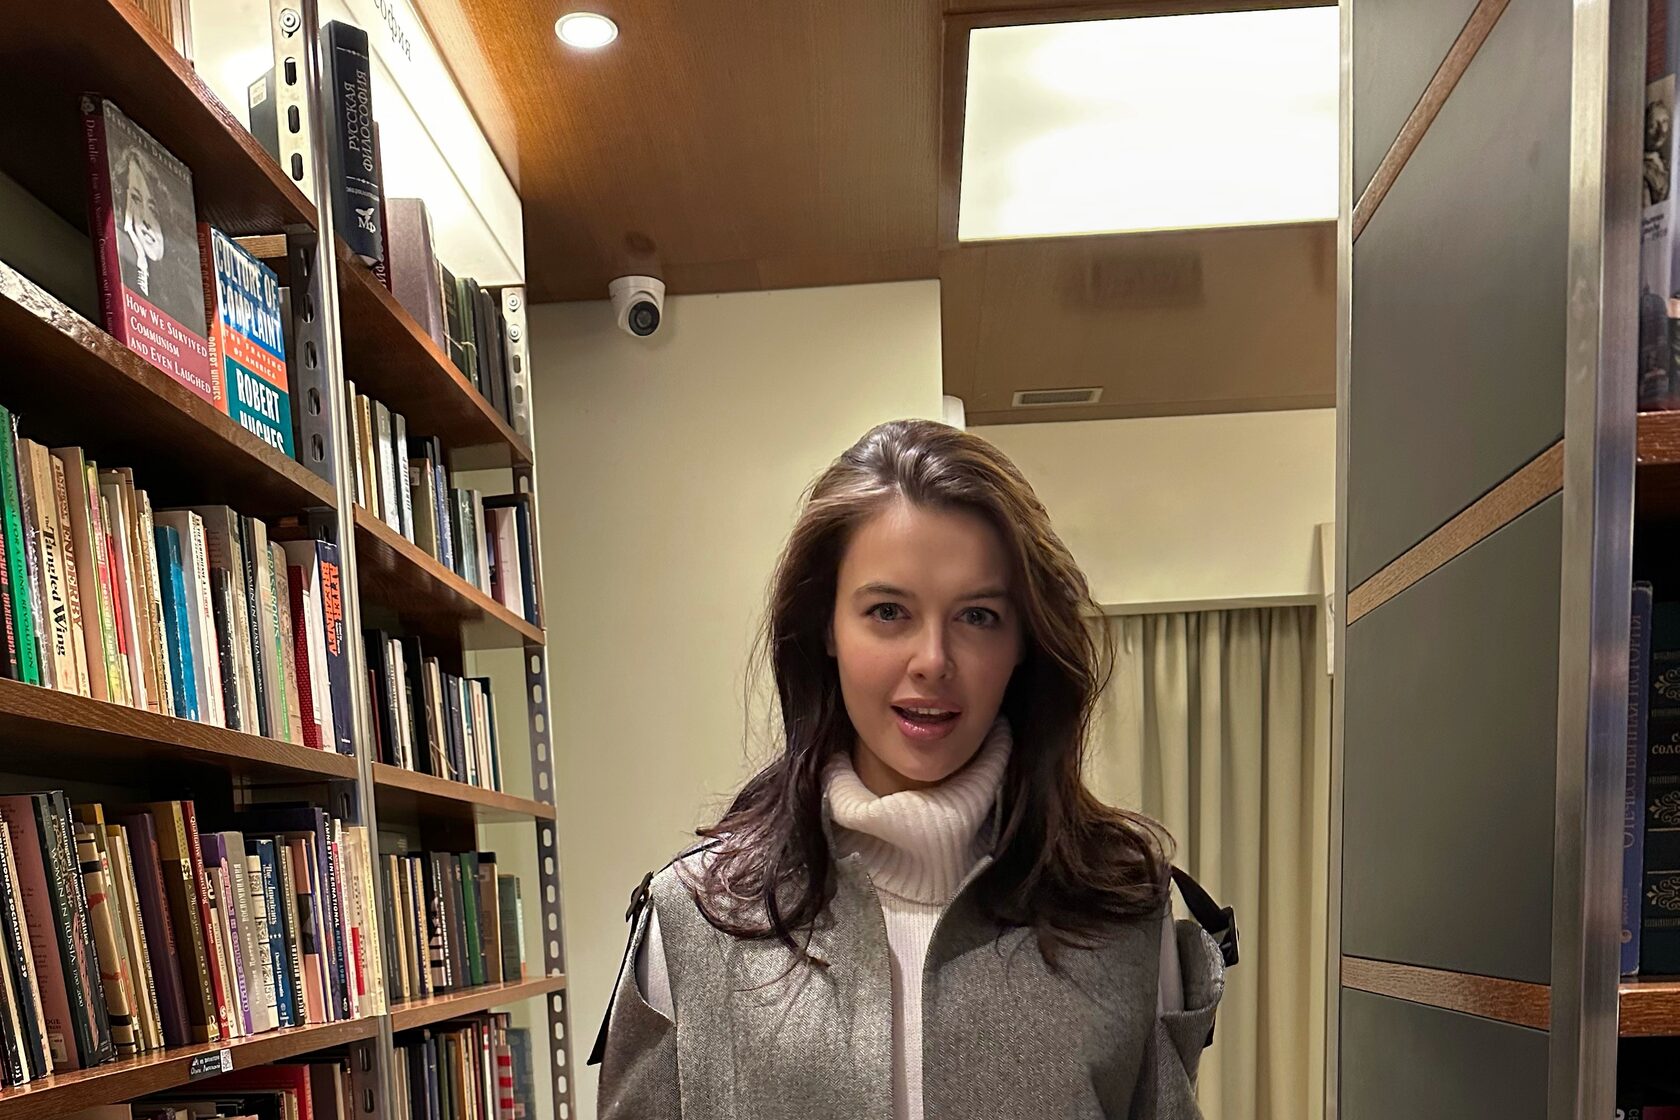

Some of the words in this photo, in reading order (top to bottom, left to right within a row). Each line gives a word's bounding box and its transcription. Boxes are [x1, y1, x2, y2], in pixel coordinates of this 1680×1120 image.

[344, 81, 360, 151] РУССКАЯ
[356, 69, 374, 172] ФИЛОСОФИЯ
[214, 236, 262, 302] CULTURE
[264, 274, 276, 311] OF
[219, 280, 282, 353] COMPLAINT
[245, 343, 283, 372] FRAYING
[245, 357, 276, 379] AMERICA
[236, 368, 280, 424] ROBERT
[15, 557, 25, 596] LIVING
[20, 598, 34, 669] REVOLUTION
[43, 526, 62, 602] Tangled
[53, 604, 68, 656] Wing
[62, 524, 83, 631] ENDERBY
[266, 549, 280, 637] GRASSROOTS
[319, 560, 336, 656] BREZHNEV
[329, 563, 341, 621] AFTER
[51, 848, 65, 898] WOMEN
[60, 902, 68, 917] IN
[60, 817, 72, 867] Huntington
[72, 872, 83, 913] American
[80, 913, 89, 946] Politics
[189, 814, 200, 856] Qualitative
[196, 856, 208, 905] Researching
[233, 863, 249, 922] ВОСПОМИНАНИЯ
[324, 821, 332, 861] AMNESTY
[328, 862, 339, 927] INTERNATIONAL
[335, 929, 343, 962] REPORT
[9, 898, 22, 950] SOCIALISM
[22, 965, 28, 978] 39
[187, 892, 202, 935] Magazine
[266, 880, 278, 925] Americans
